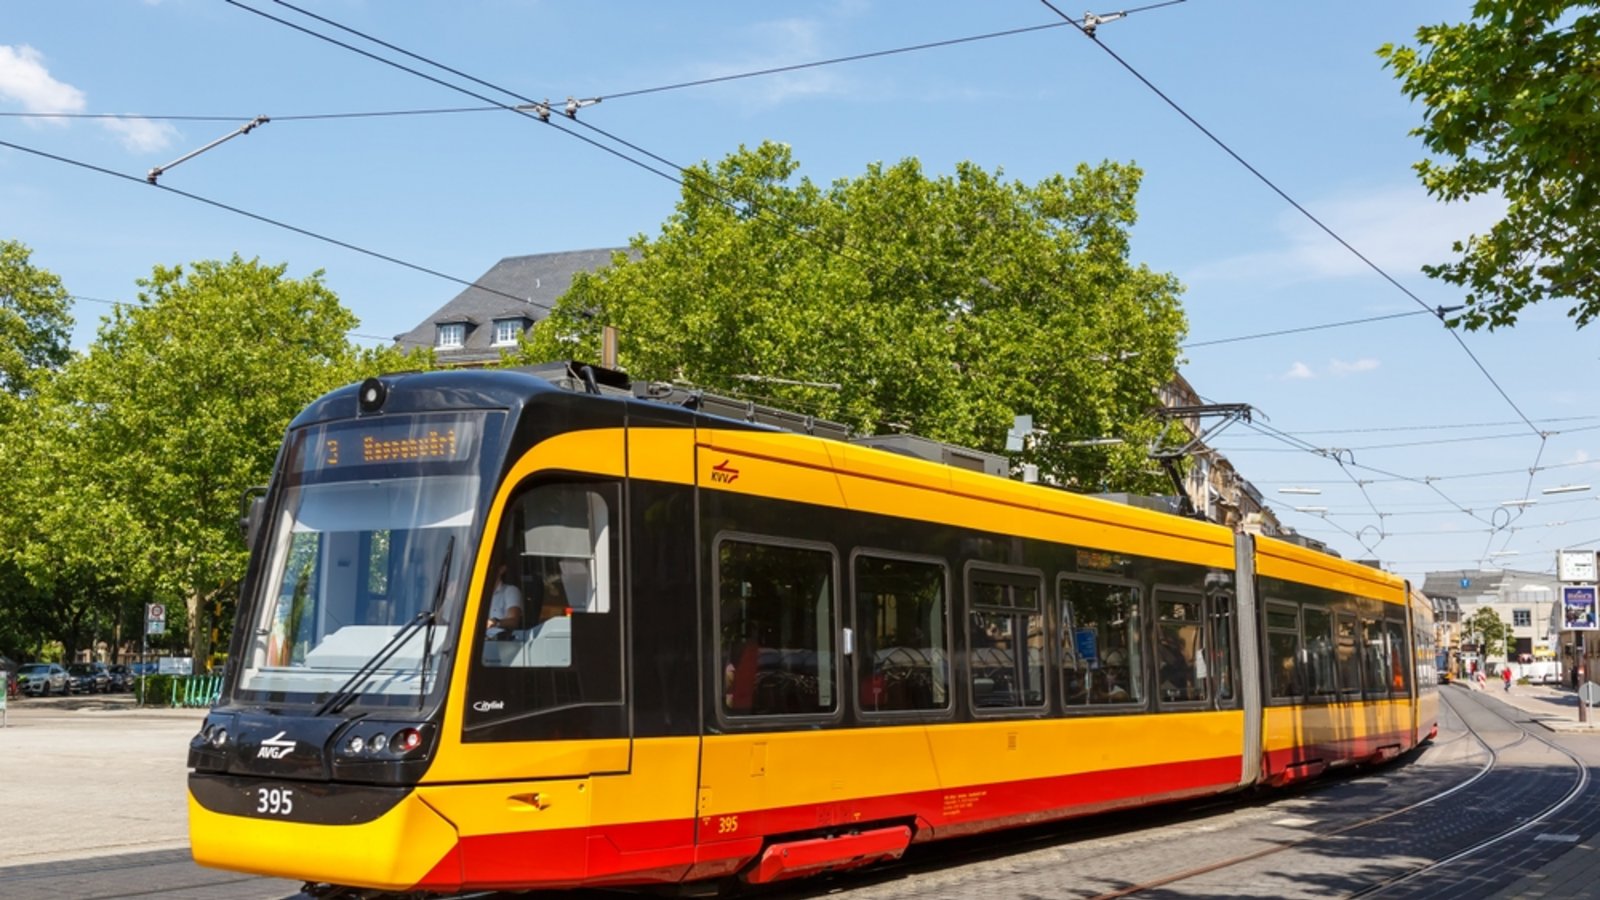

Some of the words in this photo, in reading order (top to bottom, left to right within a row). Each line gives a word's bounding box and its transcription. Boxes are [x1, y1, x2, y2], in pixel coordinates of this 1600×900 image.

[711, 471, 729, 483] KVV
[257, 746, 281, 759] AVG
[257, 788, 293, 815] 395
[718, 816, 738, 834] 395
